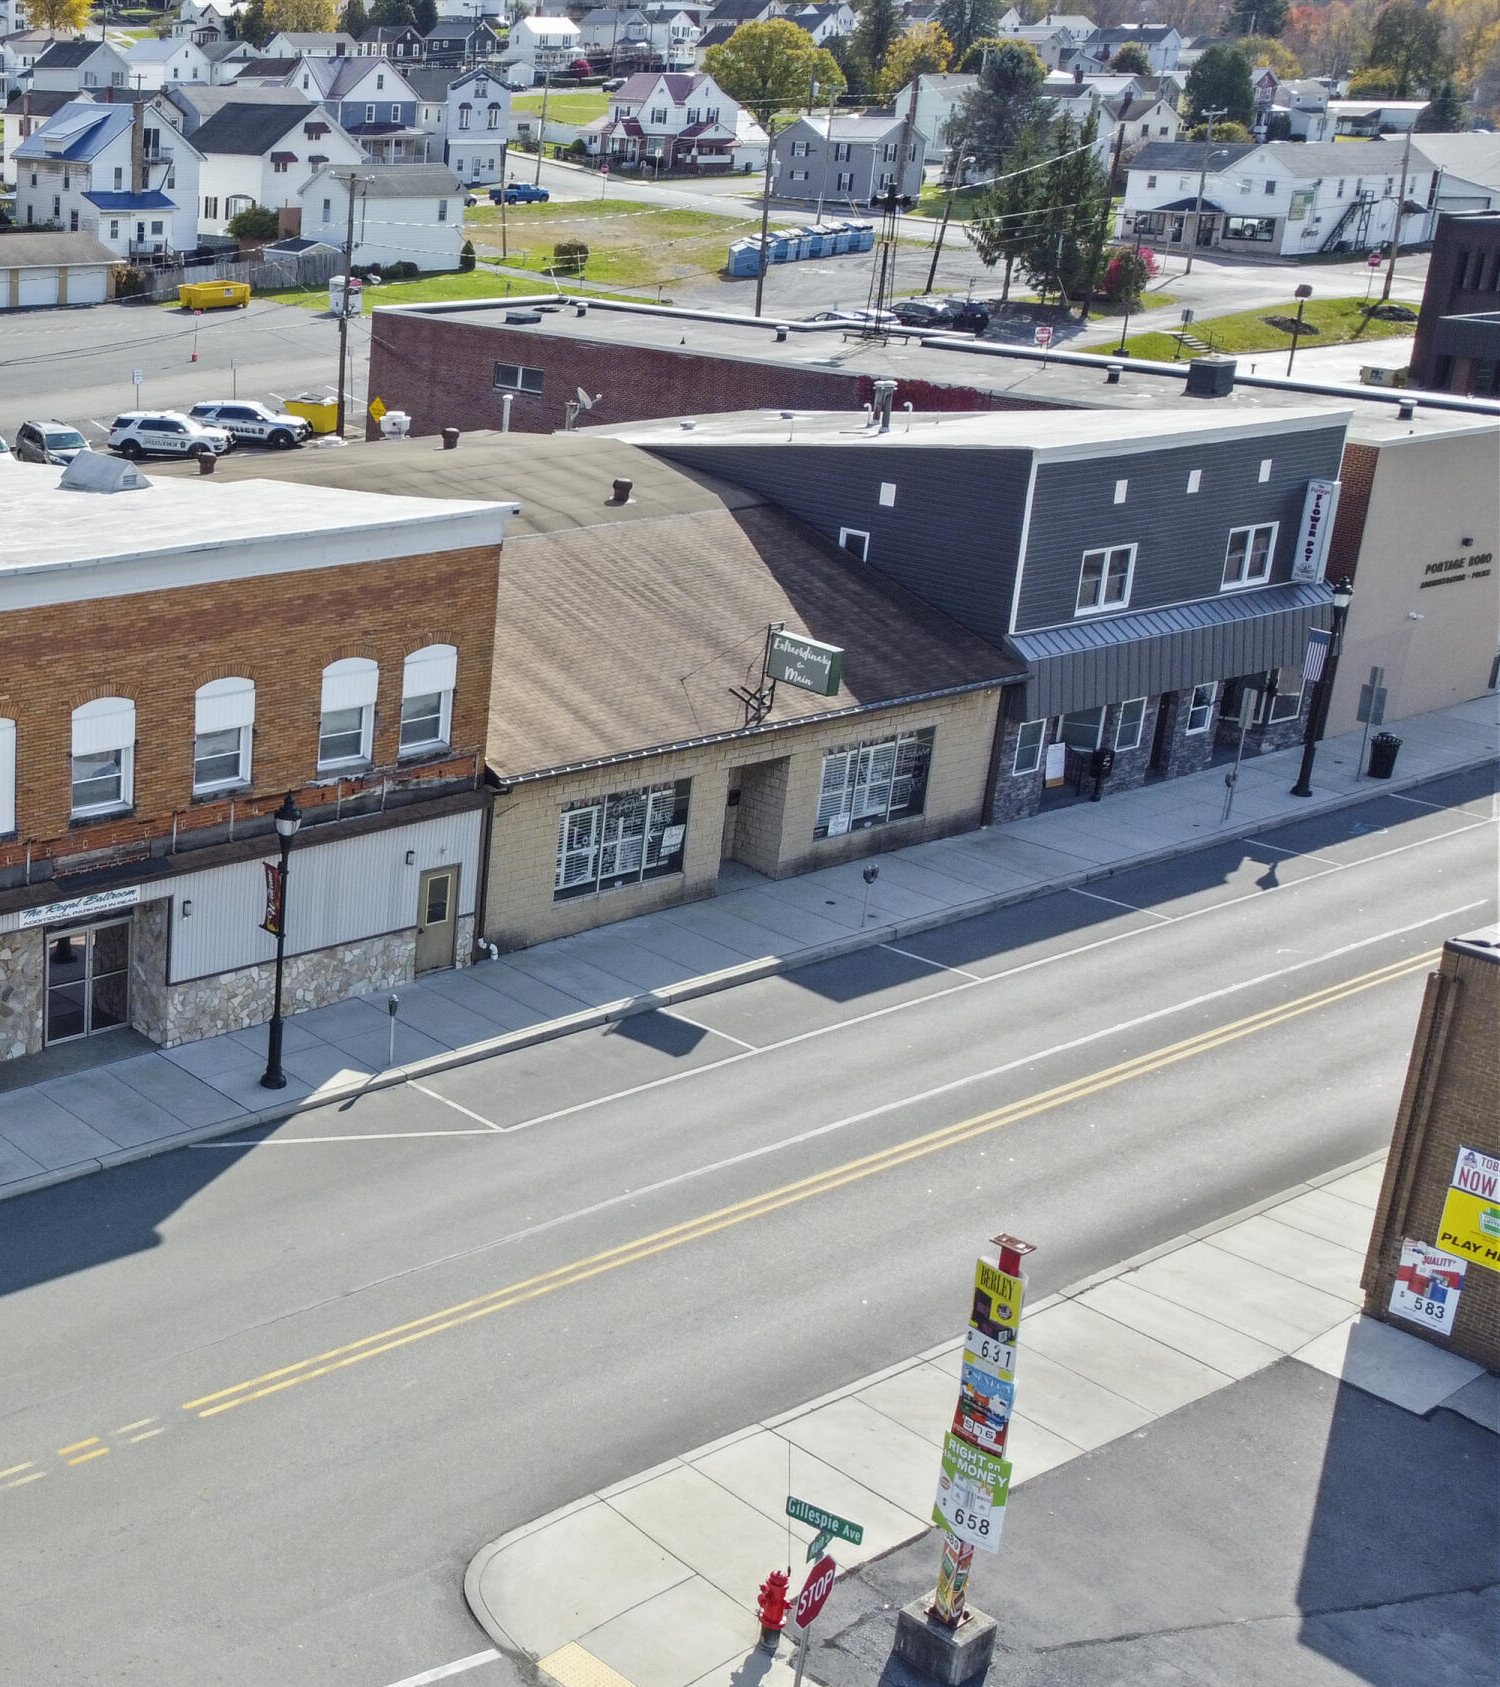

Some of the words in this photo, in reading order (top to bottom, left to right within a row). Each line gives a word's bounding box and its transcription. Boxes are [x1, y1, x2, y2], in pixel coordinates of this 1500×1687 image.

[1308, 494, 1323, 538] FLOWER
[1304, 540, 1315, 562] POT
[1425, 557, 1466, 575] PORTAGE
[1468, 553, 1493, 567] BORO
[773, 637, 832, 675] Extraordinary
[784, 666, 813, 686] Main
[22, 908, 42, 919] The
[45, 899, 81, 914] Royal
[83, 889, 137, 906] Ballroom
[22, 912, 70, 926] ADDITIONAL
[72, 904, 107, 915] PARKING
[1481, 1156, 1500, 1174] TOB
[1457, 1166, 1498, 1198] NOW
[1441, 1232, 1482, 1253] PLAY
[980, 1264, 1016, 1301] BERLEY
[1414, 1297, 1445, 1319] 583
[944, 1449, 957, 1464] the
[957, 1459, 1008, 1488] MONEY
[948, 1439, 987, 1467] RIGHT
[987, 1462, 1001, 1473] on
[788, 1498, 839, 1532] Gillespie
[842, 1524, 861, 1542] Ave
[954, 1508, 990, 1536] 658
[798, 1569, 834, 1616] STOP
